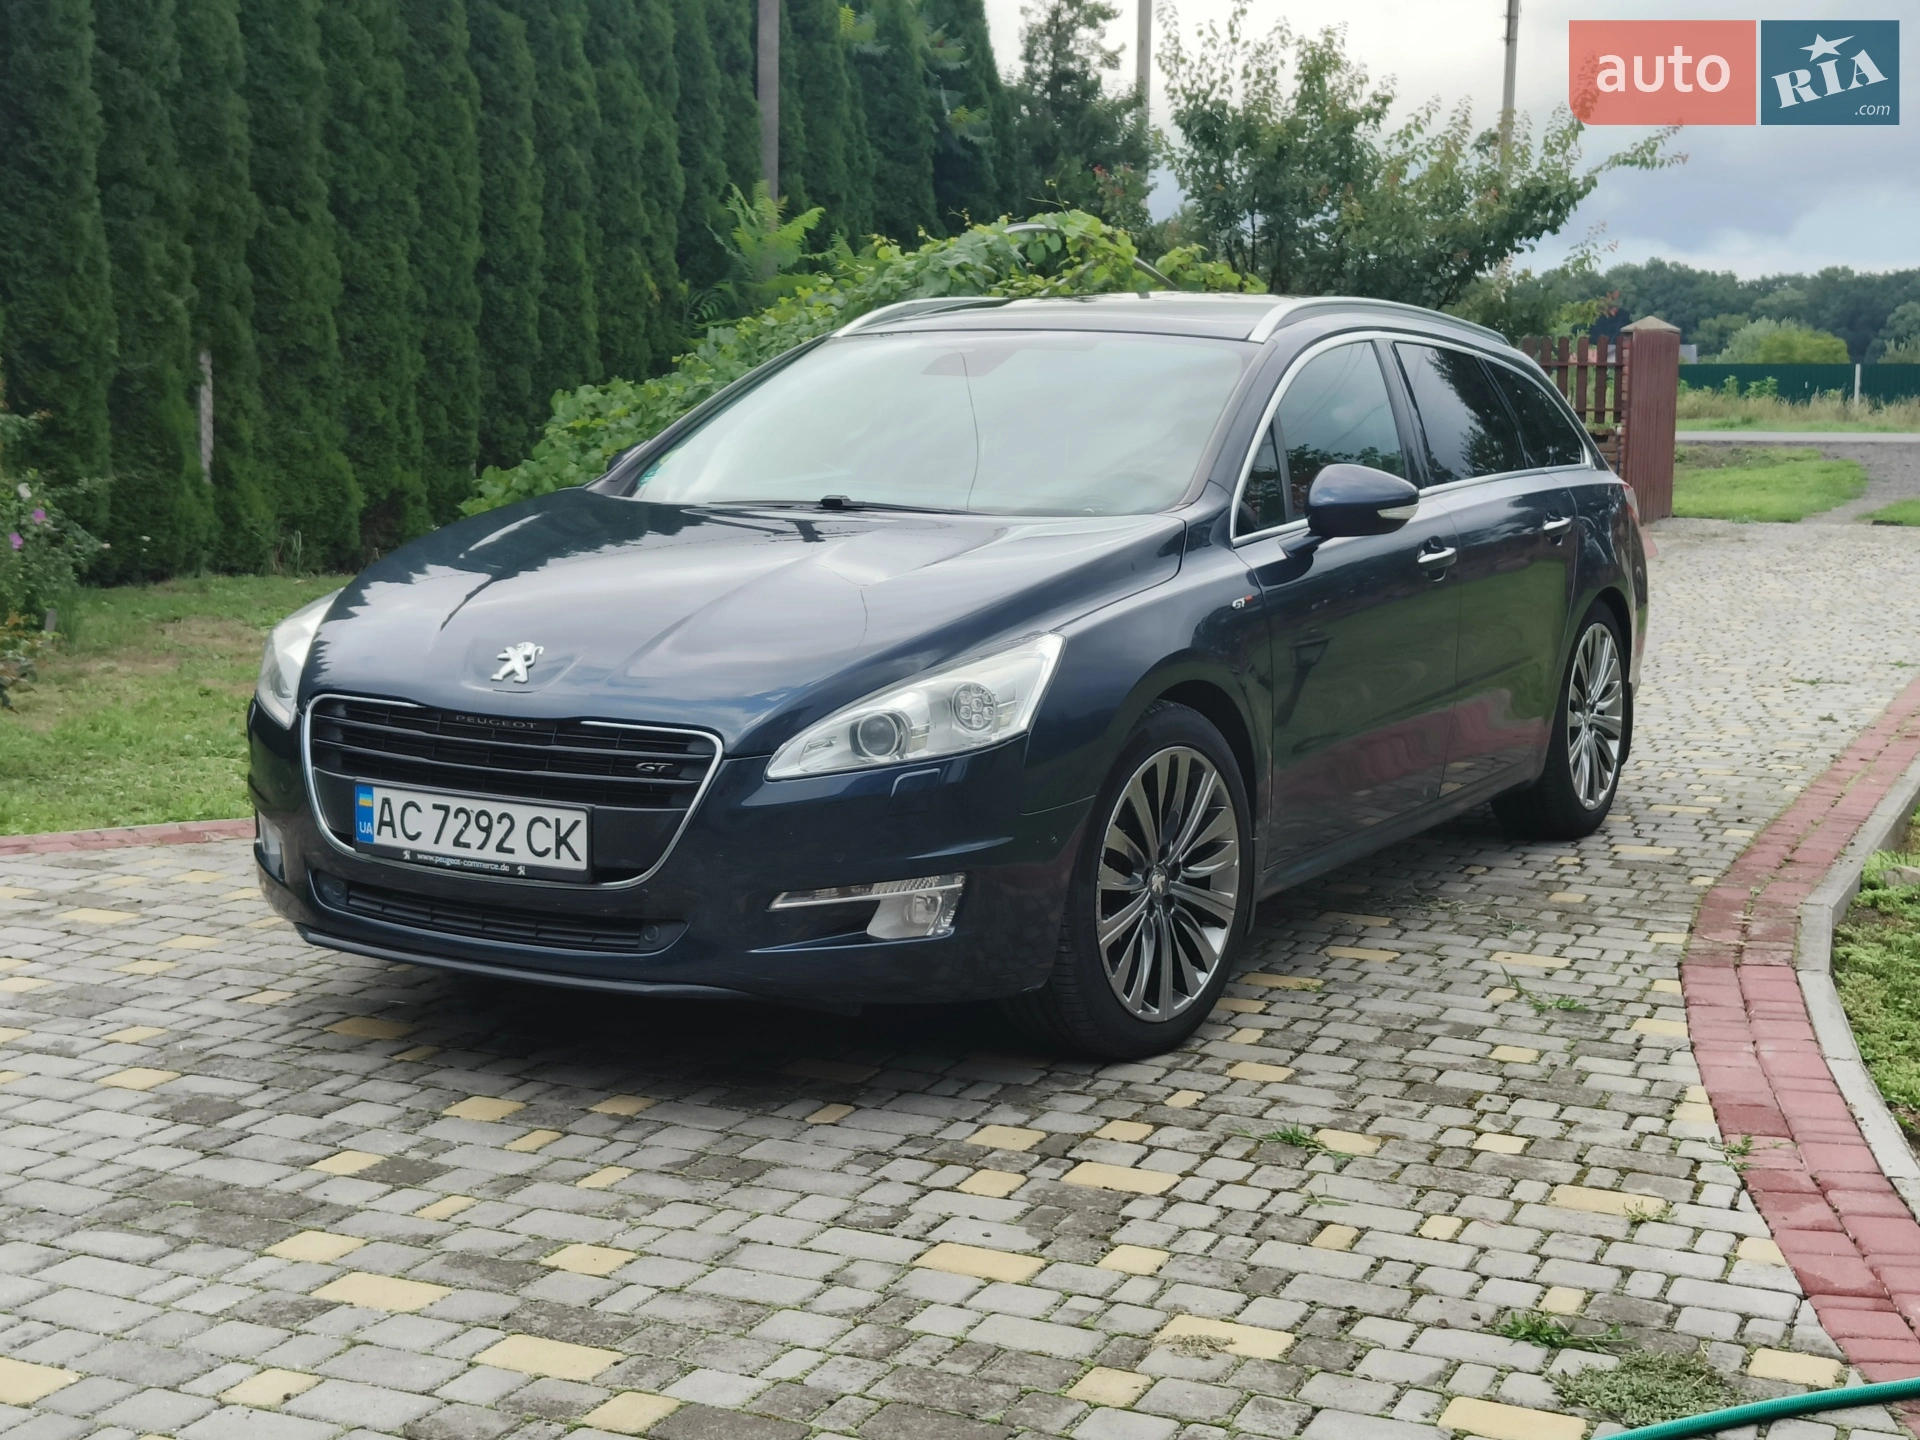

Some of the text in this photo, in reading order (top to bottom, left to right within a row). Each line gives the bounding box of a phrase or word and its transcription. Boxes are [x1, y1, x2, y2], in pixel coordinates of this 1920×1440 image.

[456, 715, 538, 730] PEUGEOT
[635, 762, 674, 773] GT
[359, 821, 373, 834] UA
[376, 797, 582, 862] AC 7292 CK
[416, 853, 510, 872] www.peugeot-commerce.de
